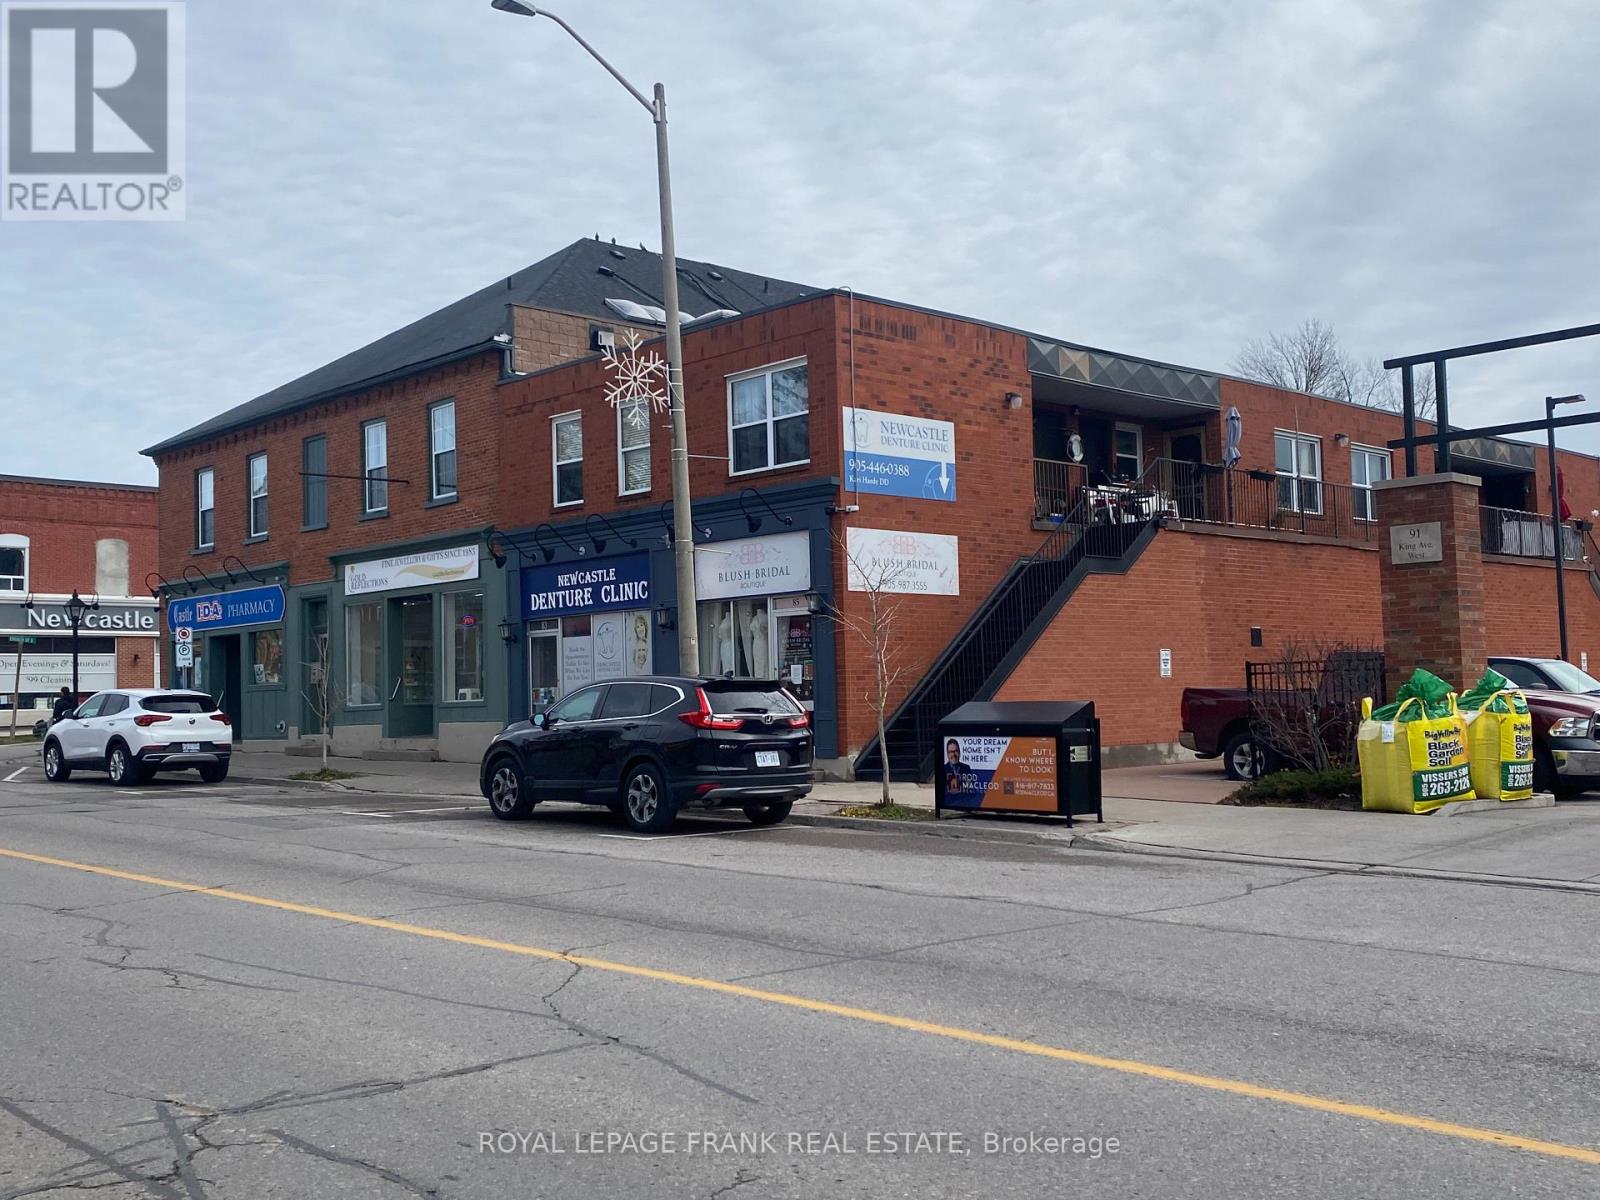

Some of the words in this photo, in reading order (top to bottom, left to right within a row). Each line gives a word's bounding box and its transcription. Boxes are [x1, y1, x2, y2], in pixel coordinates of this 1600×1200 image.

[880, 420, 949, 441] NEWCASTLE
[881, 435, 920, 449] DENTURE
[921, 440, 949, 453] CLINIC
[1409, 529, 1420, 538] 91
[1399, 543, 1416, 551] King
[871, 557, 903, 568] BLUSH
[907, 560, 938, 570] BRIDAL
[558, 568, 616, 587] NEWCASTLE
[718, 570, 751, 582] BLUSH
[756, 565, 791, 579] BRIDAL
[531, 588, 593, 611] DENTURE
[601, 581, 648, 603] CLINIC
[227, 599, 275, 618] PHARMACY
[22, 660, 59, 669] Evenings
[1428, 740, 1459, 750] Black
[1428, 747, 1464, 758] Garden
[1029, 757, 1054, 765] WHERE
[1429, 758, 1450, 767] Soil
[1421, 770, 1458, 783] VISSERS
[962, 782, 999, 790] MACLEOD
